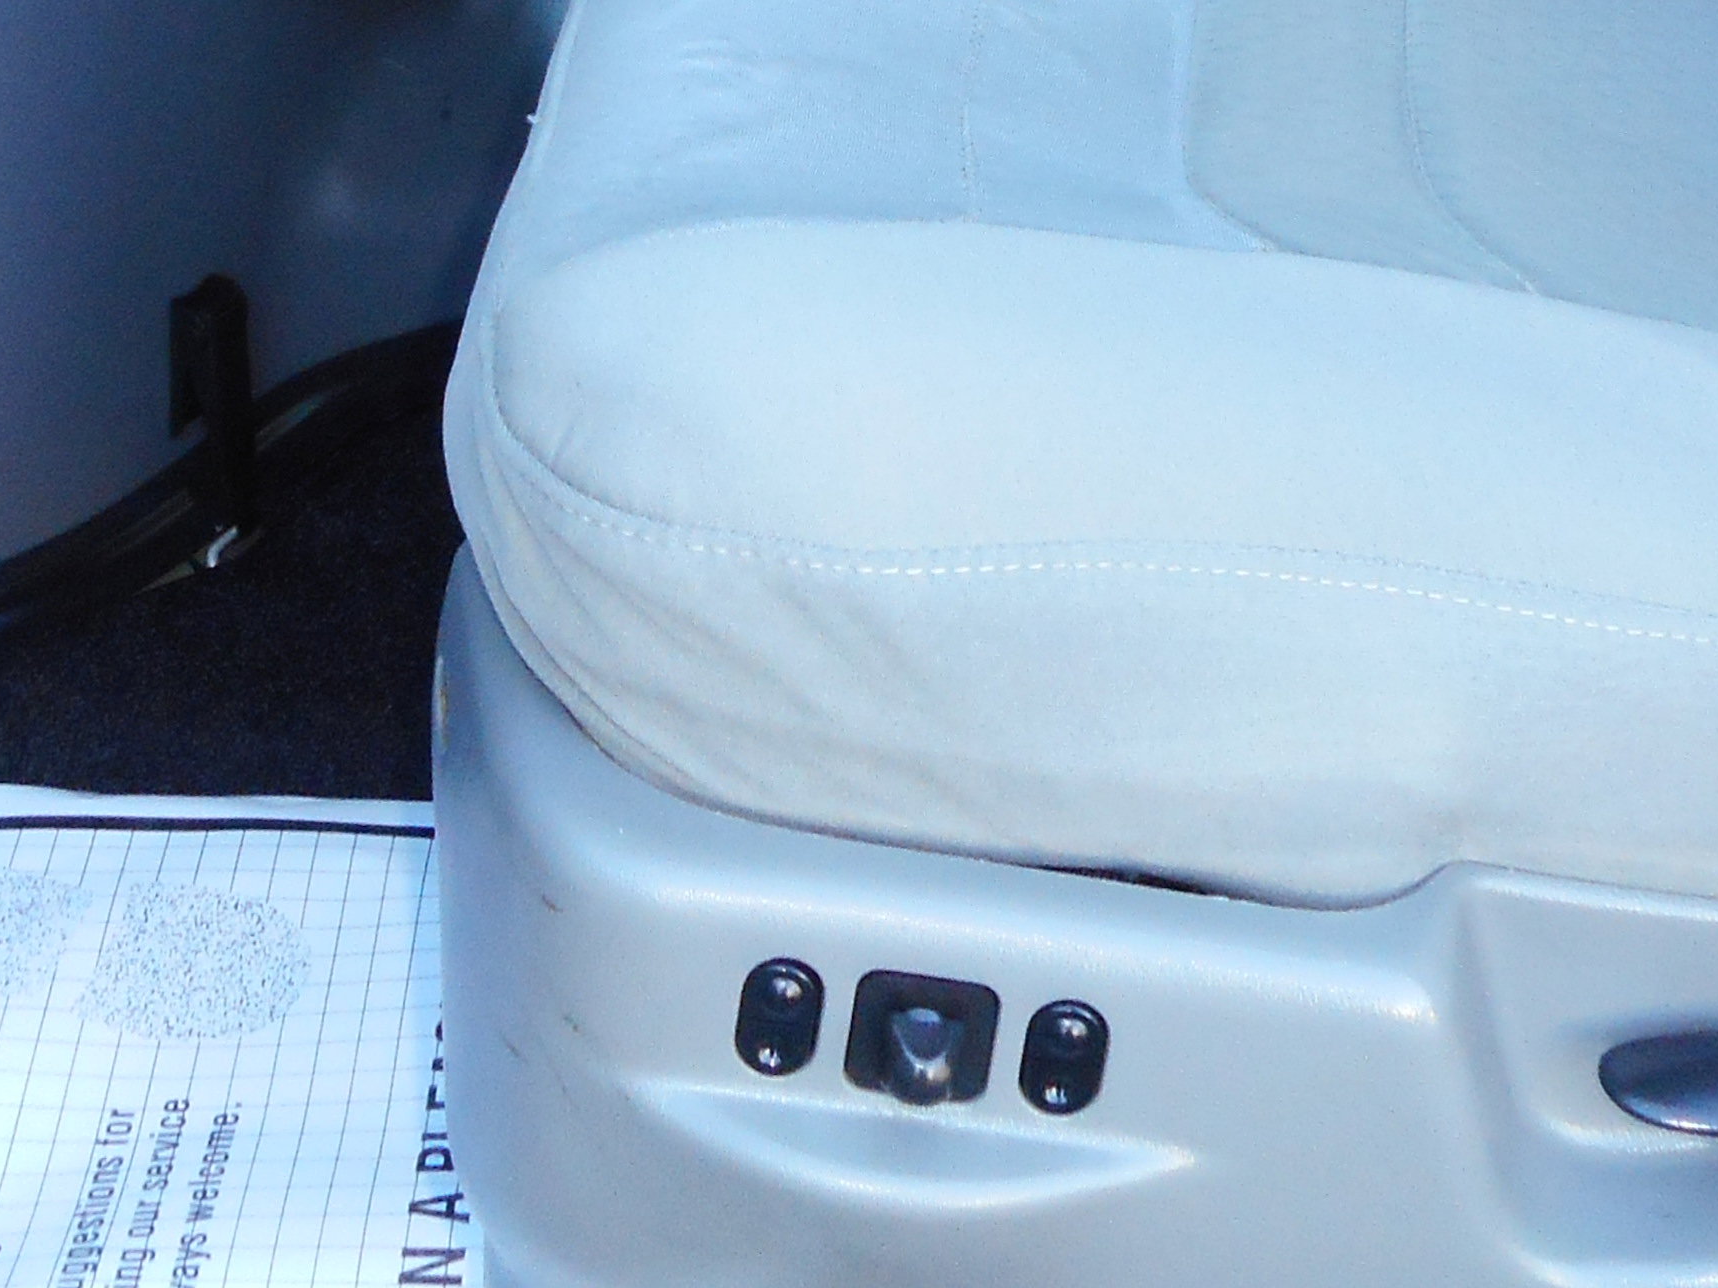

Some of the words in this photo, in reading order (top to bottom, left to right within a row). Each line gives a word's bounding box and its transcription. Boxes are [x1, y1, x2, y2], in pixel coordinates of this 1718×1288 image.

[96, 1107, 137, 1160] for
[143, 1098, 191, 1191] service
[185, 1100, 244, 1220] welcome.
[127, 1198, 163, 1239] our
